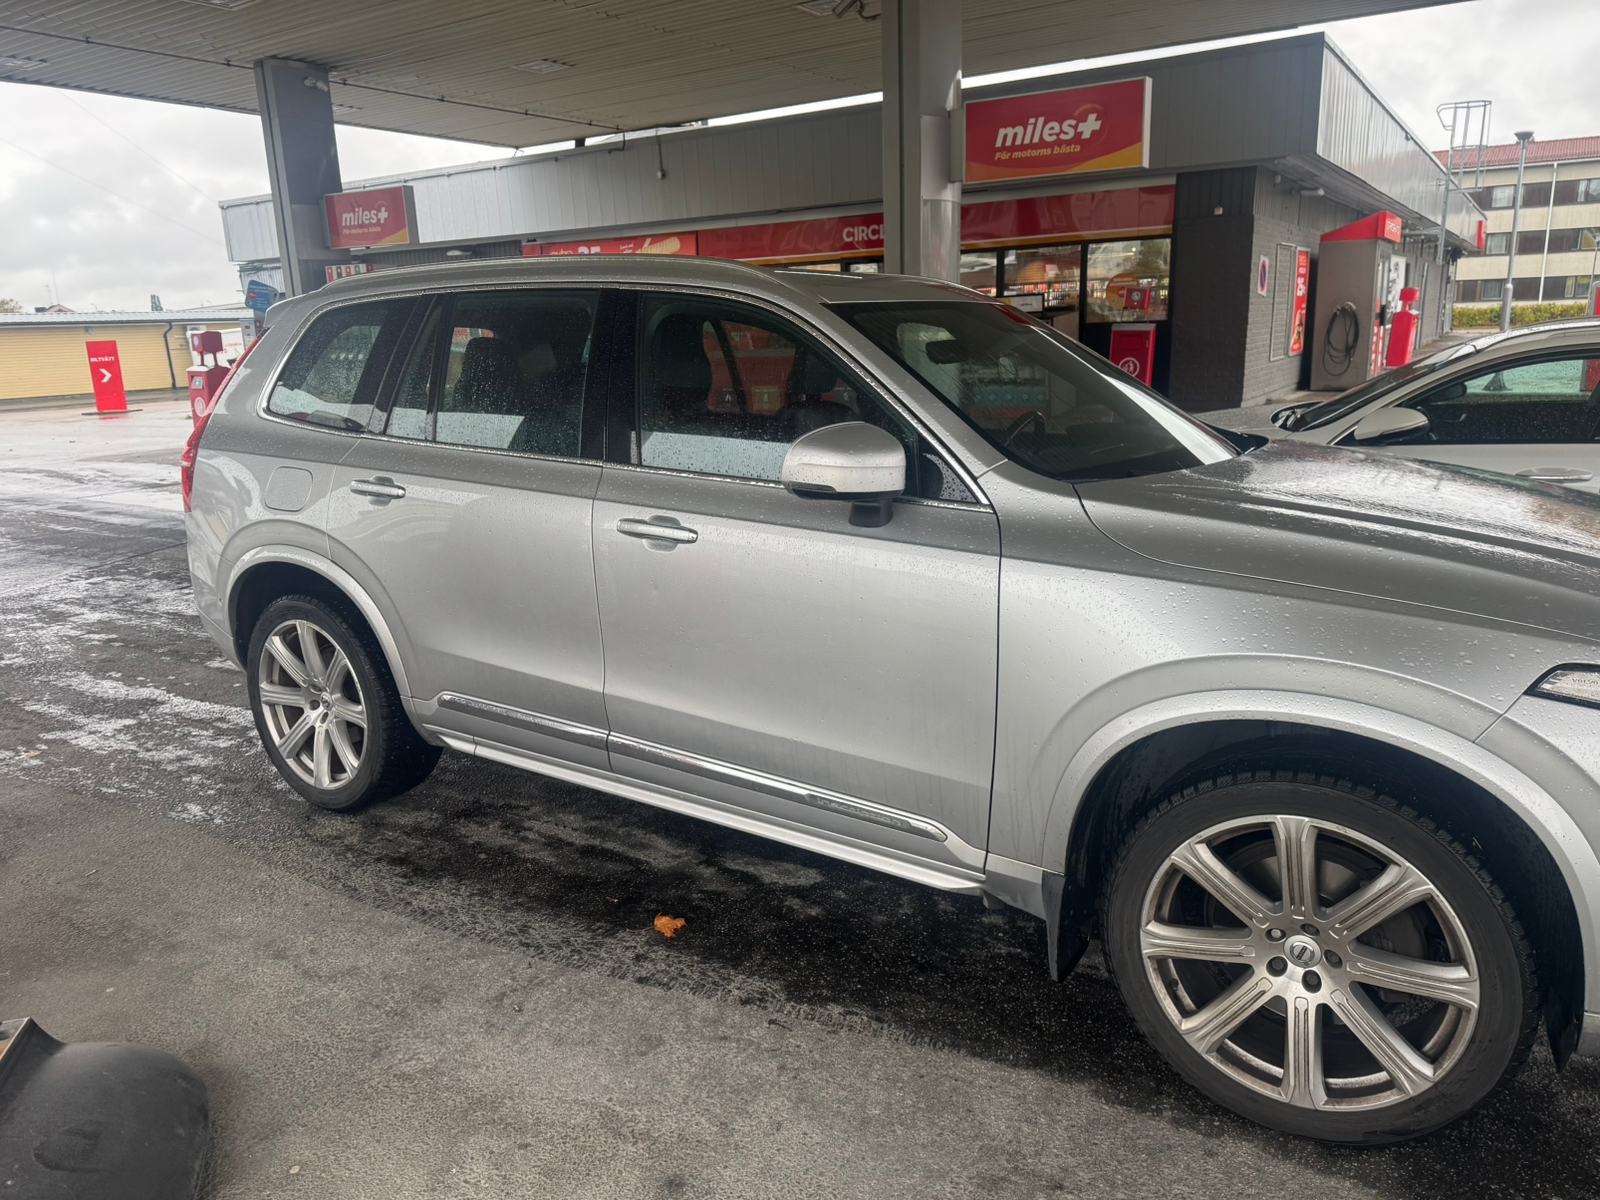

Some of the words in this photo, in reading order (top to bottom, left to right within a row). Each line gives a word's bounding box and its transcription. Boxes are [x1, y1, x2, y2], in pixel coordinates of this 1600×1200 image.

[995, 113, 1102, 147] miles+
[994, 151, 1011, 161] För
[1011, 147, 1052, 159] motorns
[1054, 143, 1081, 154] bästa
[342, 207, 388, 226] miles+
